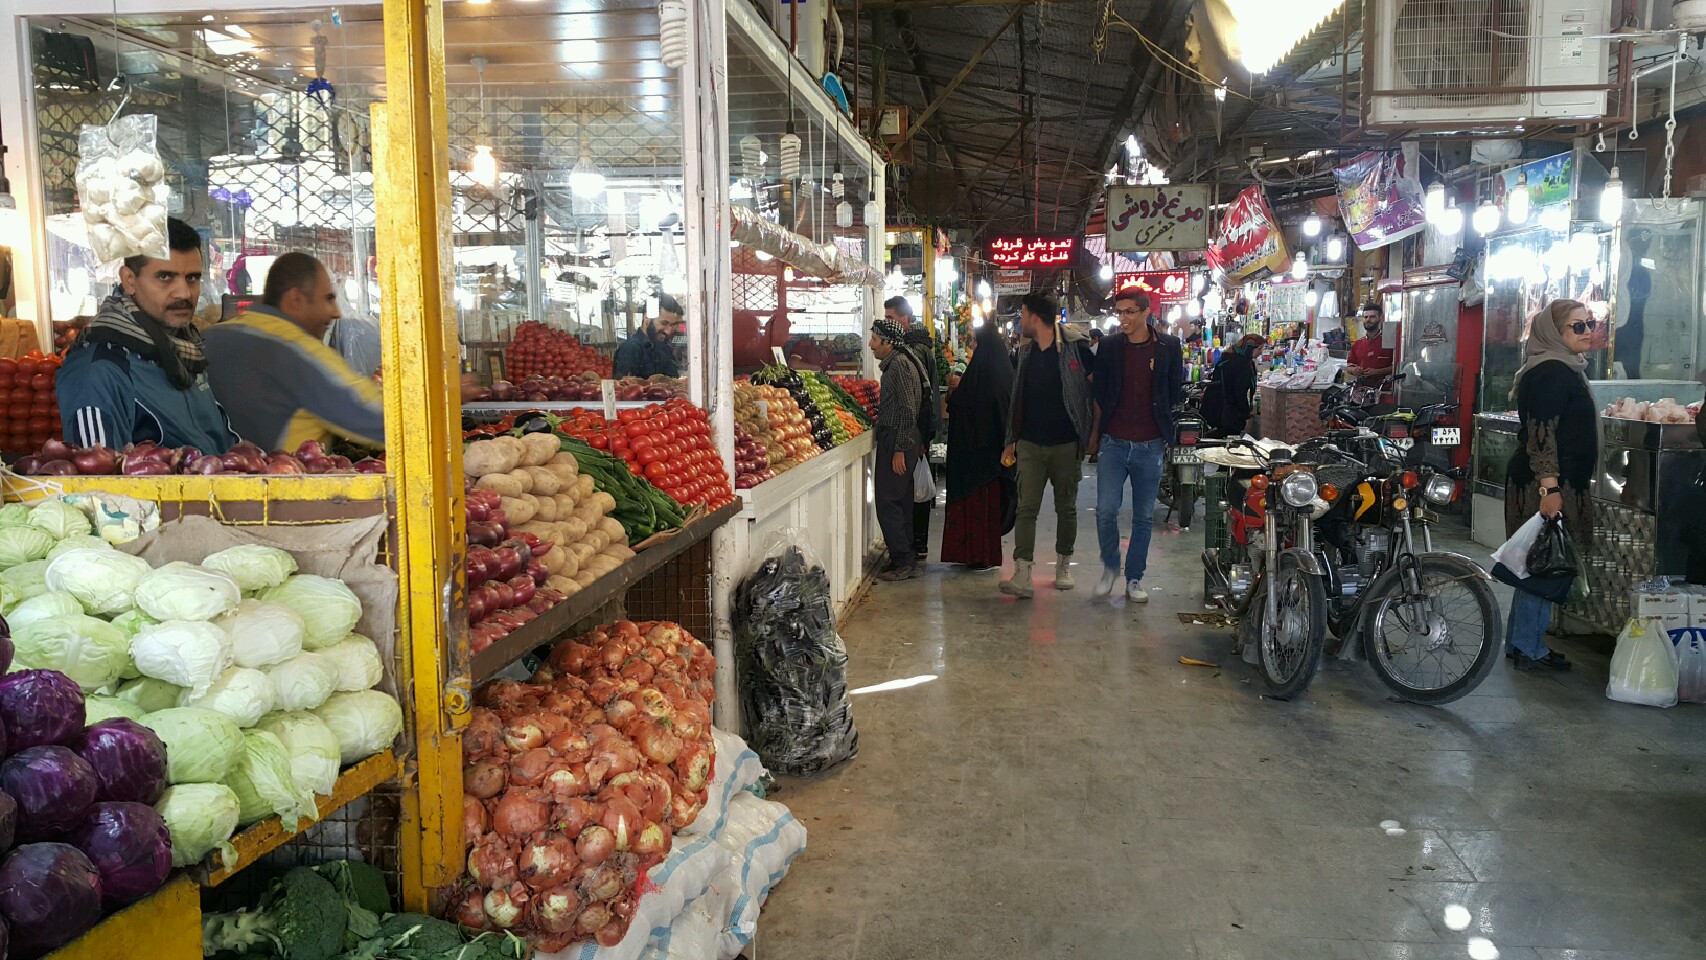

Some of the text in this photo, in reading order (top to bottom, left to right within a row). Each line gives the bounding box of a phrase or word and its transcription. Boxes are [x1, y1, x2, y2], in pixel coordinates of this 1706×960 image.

[1111, 186, 1204, 232] مرغ فروشی
[1135, 220, 1176, 246] جعفری
[991, 237, 1023, 251] ظروف
[1039, 250, 1069, 263] فلزی
